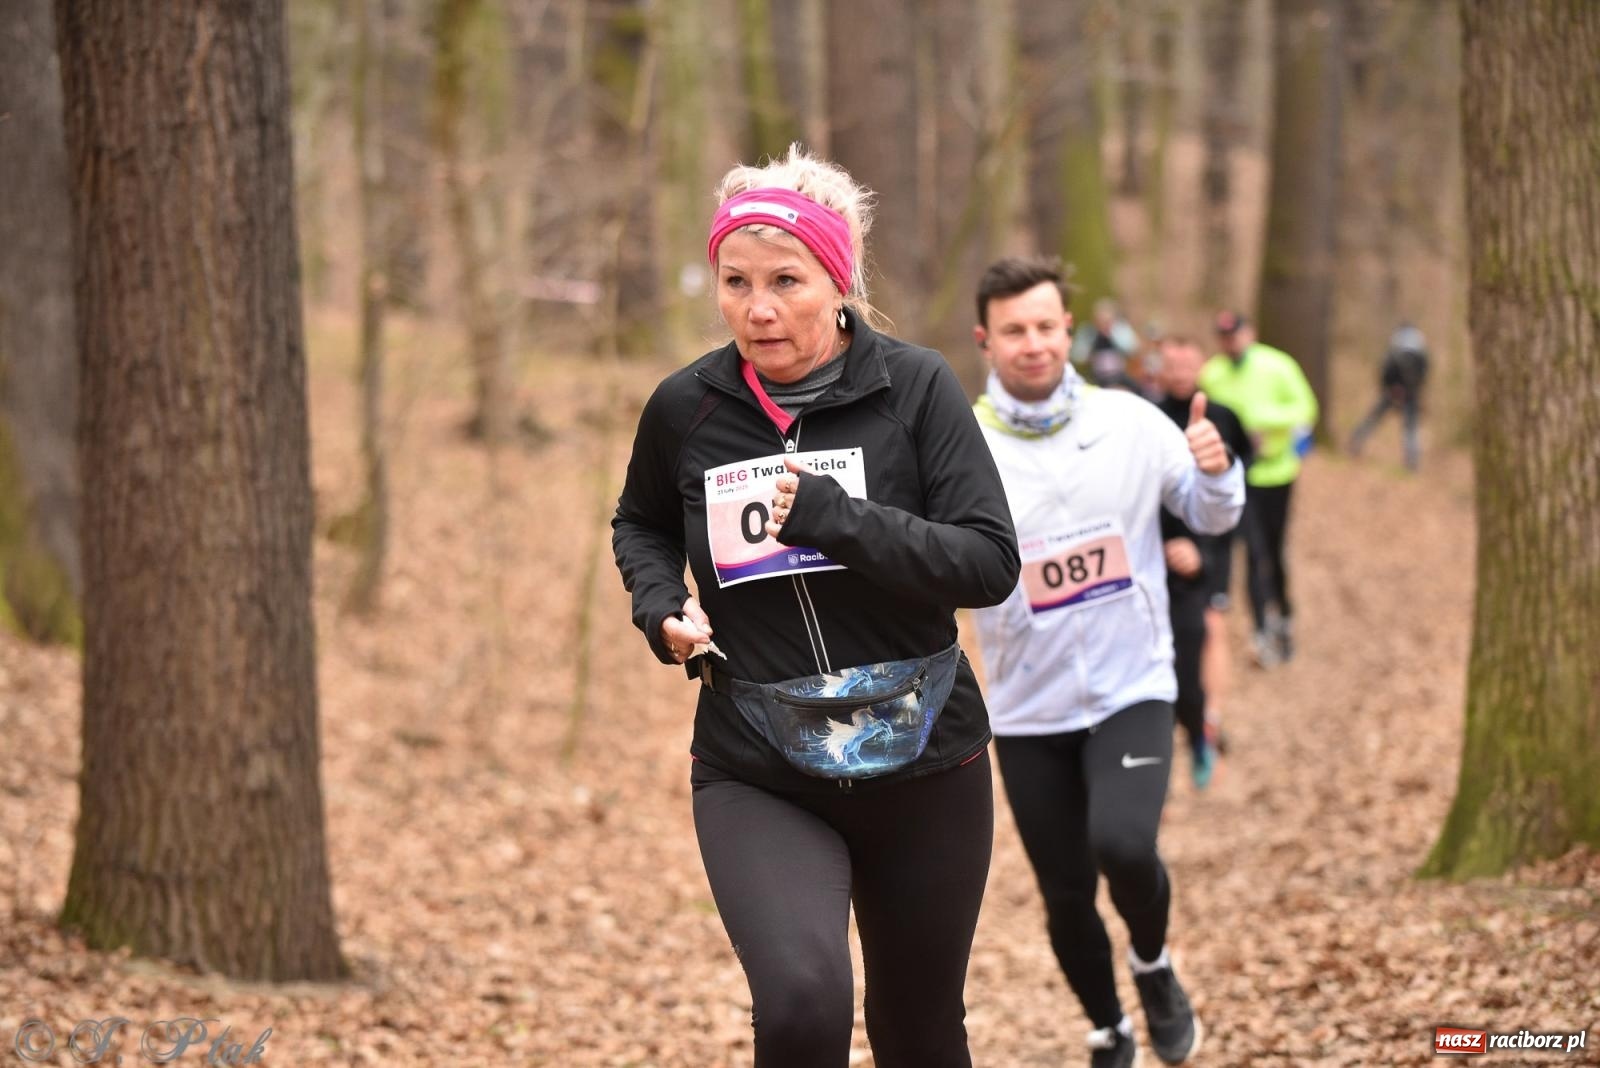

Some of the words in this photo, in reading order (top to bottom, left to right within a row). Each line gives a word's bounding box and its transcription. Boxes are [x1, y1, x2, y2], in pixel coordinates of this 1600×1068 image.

[716, 469, 748, 487] BIEG
[751, 458, 847, 479] Twaiela
[799, 551, 829, 562] Racib
[1042, 547, 1105, 588] 087
